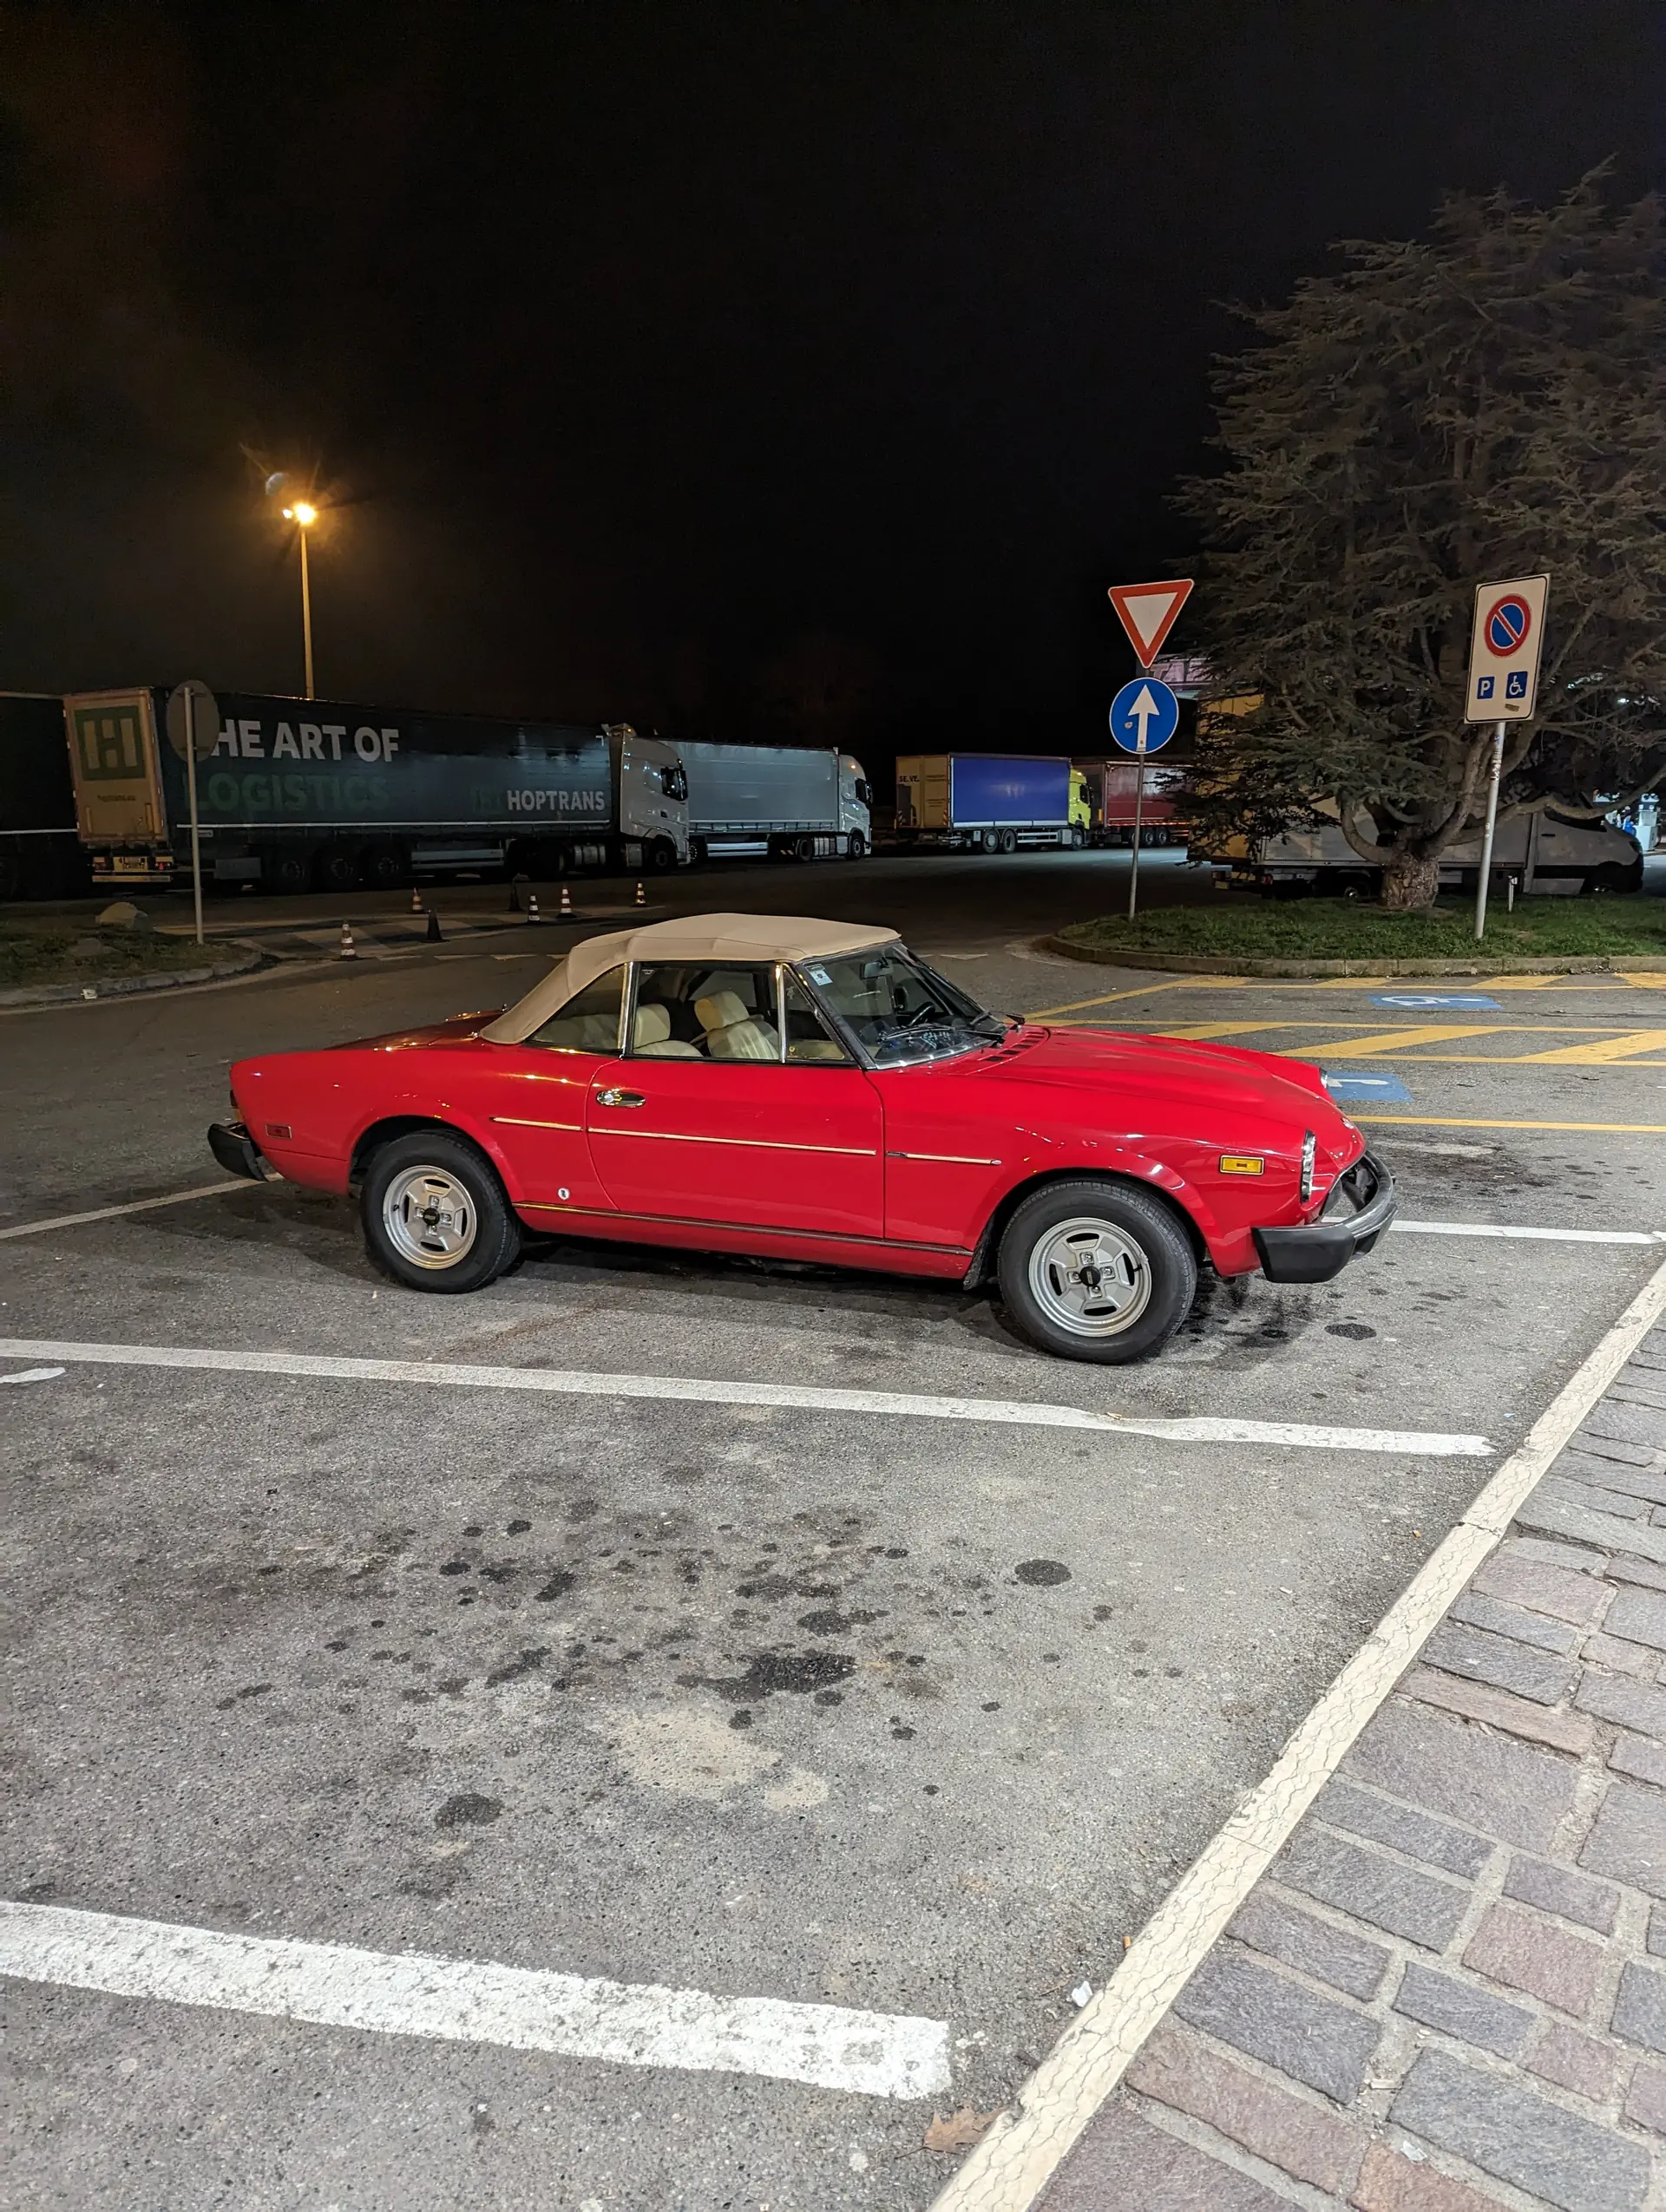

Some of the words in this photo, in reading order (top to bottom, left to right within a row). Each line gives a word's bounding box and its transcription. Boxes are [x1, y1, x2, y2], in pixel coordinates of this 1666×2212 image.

[1479, 679, 1491, 697] P
[211, 718, 266, 758] HE
[272, 722, 347, 761] ART
[353, 725, 400, 763] OF
[182, 771, 390, 812] LOGISTICS
[506, 789, 606, 811] HOPTRANS
